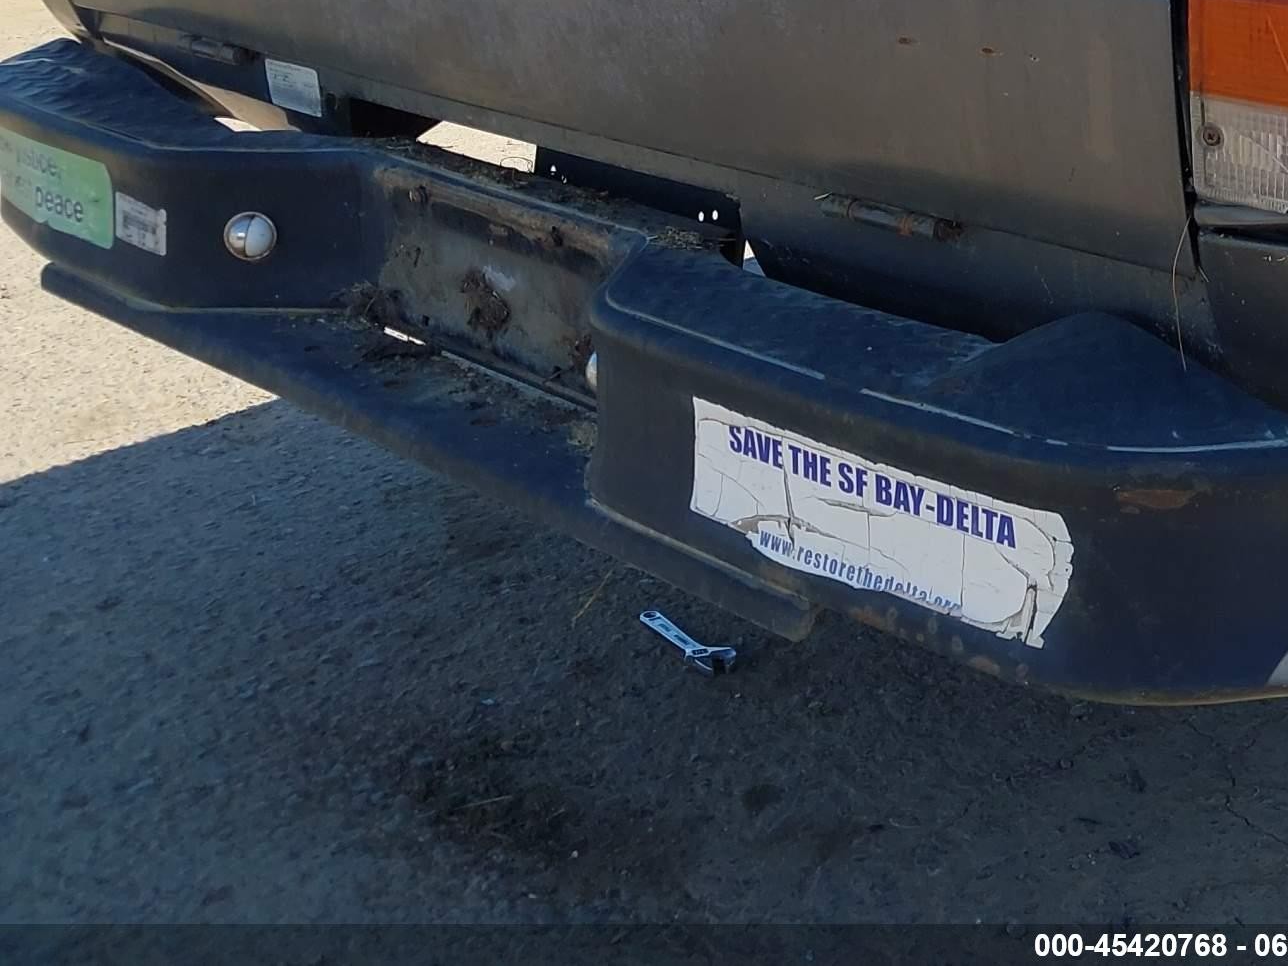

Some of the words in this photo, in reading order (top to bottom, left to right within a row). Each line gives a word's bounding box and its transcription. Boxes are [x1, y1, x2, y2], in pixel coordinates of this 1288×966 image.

[35, 185, 84, 223] peace
[729, 425, 784, 469] SAVE
[788, 443, 832, 487] THE
[838, 462, 868, 497] SF
[875, 474, 1016, 549] BAY-DELTA
